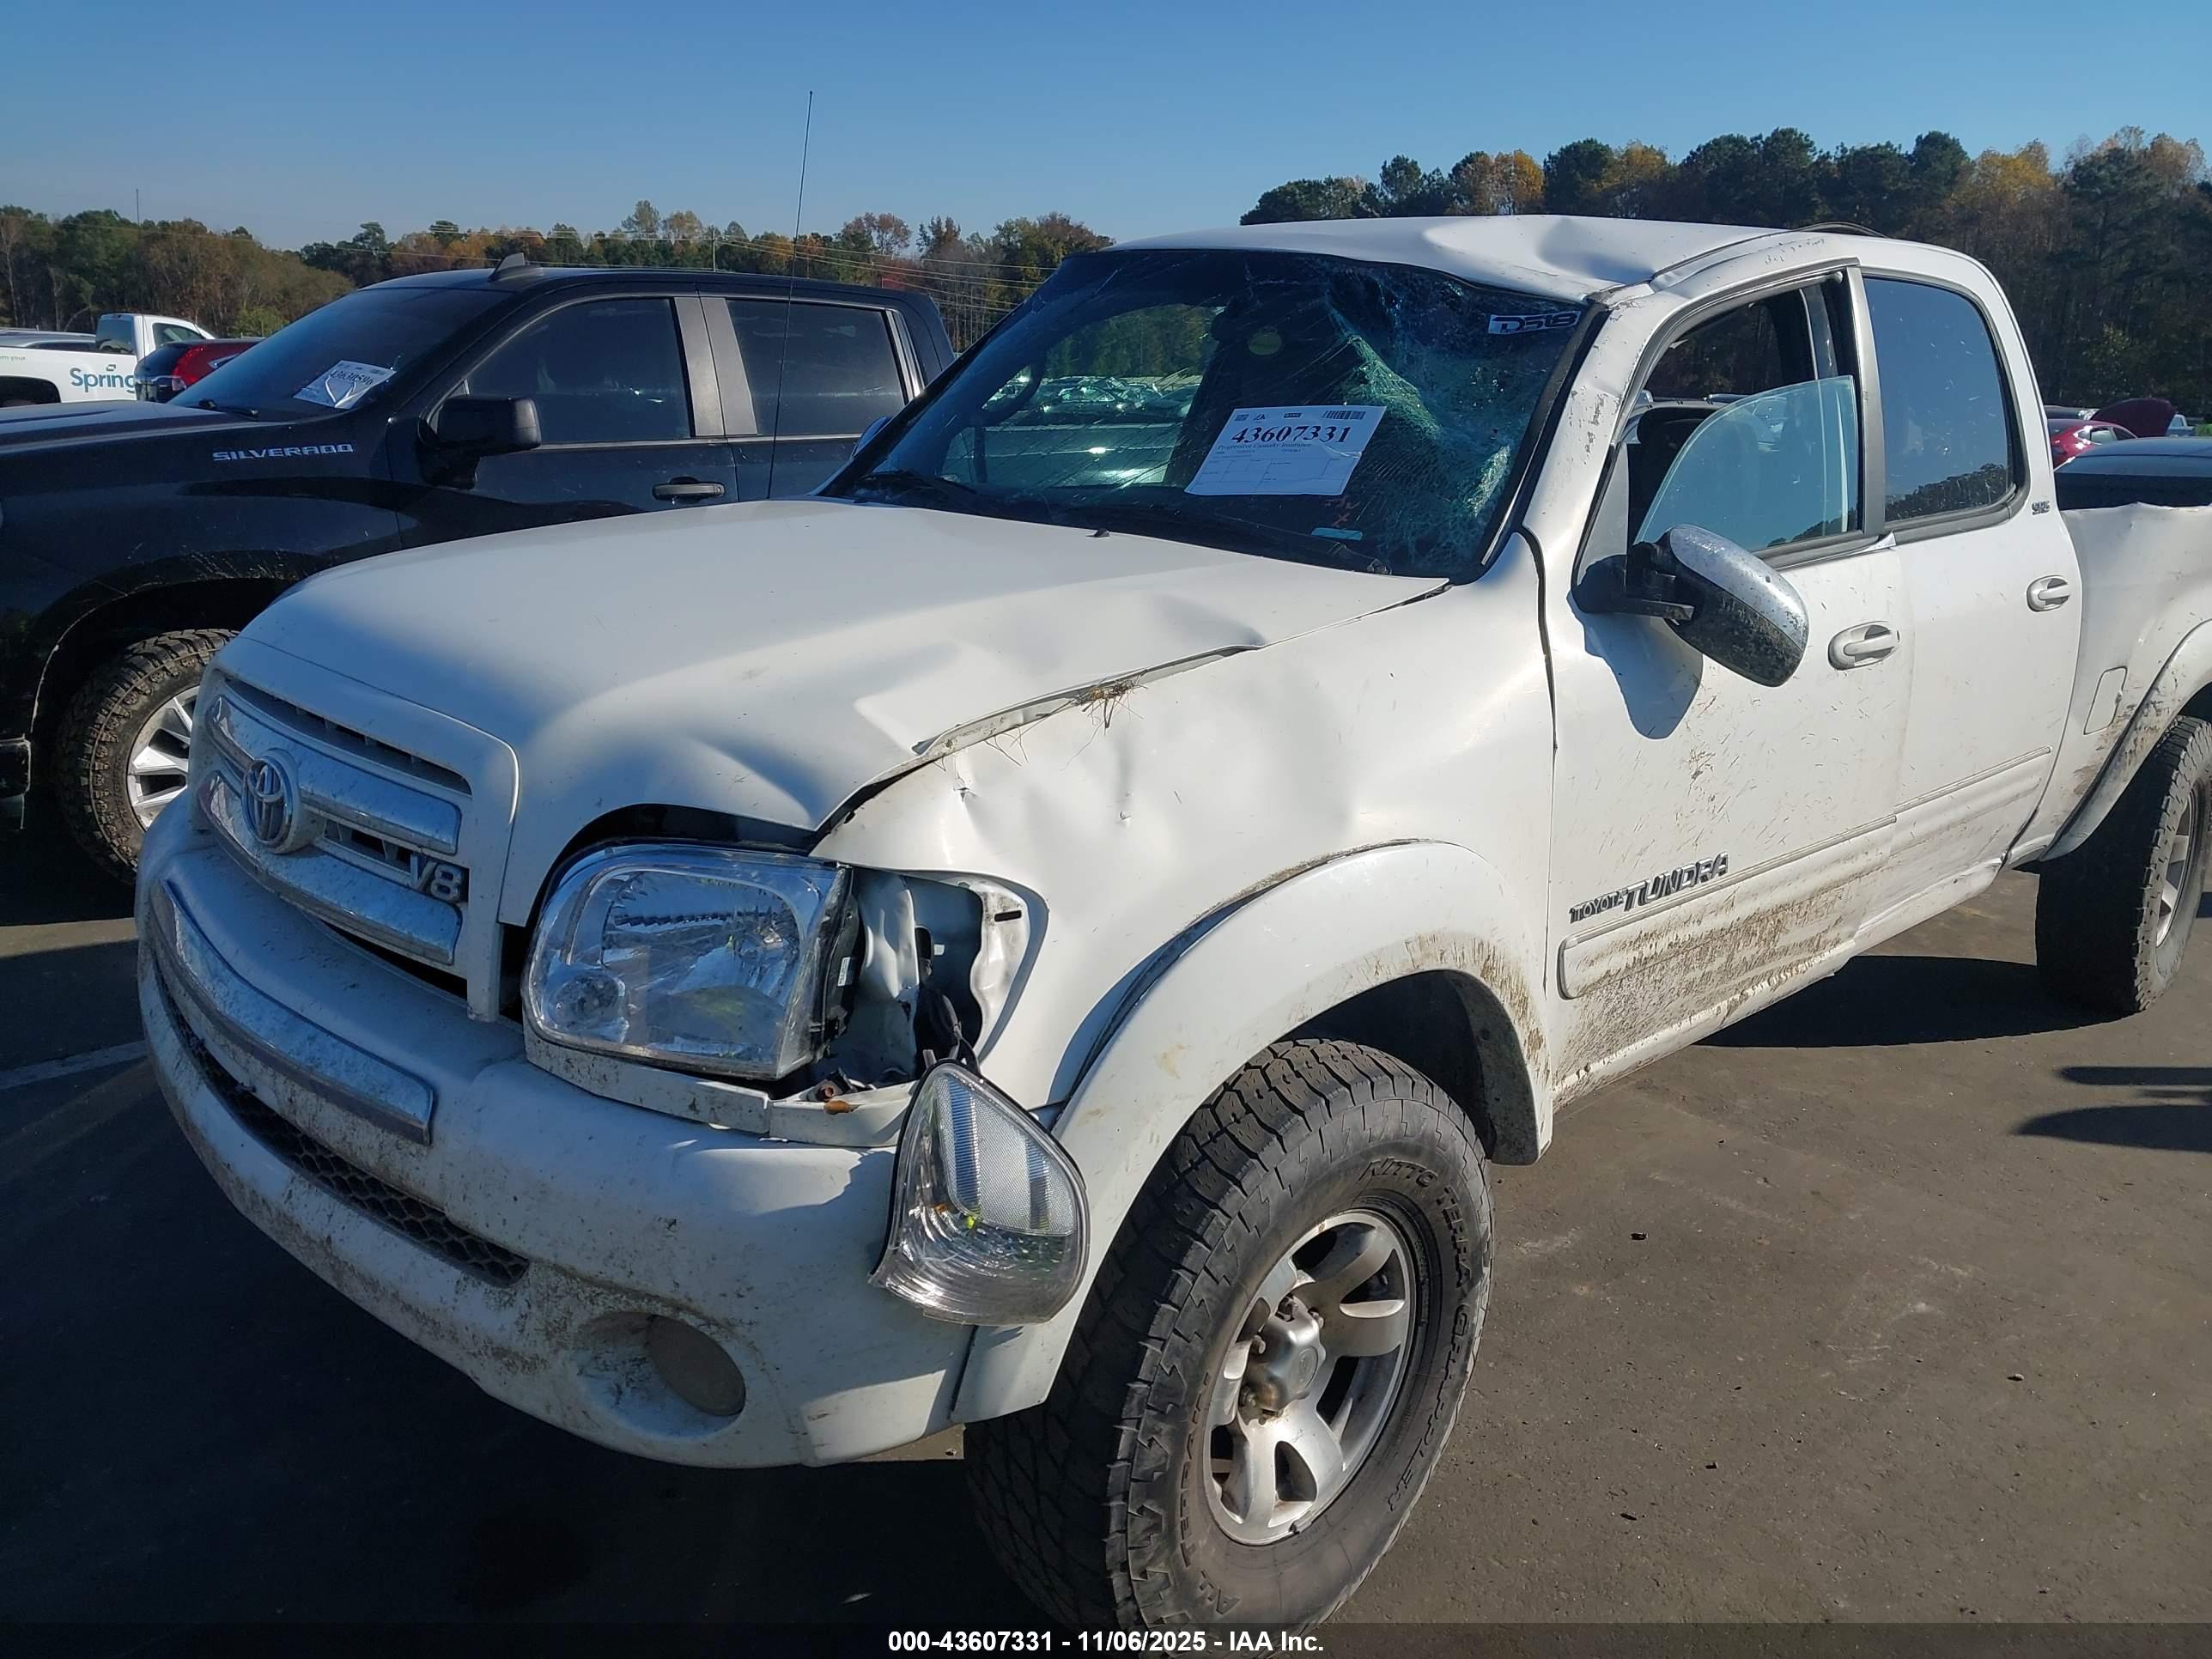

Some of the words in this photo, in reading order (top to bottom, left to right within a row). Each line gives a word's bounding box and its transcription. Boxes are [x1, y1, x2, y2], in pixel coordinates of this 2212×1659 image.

[212, 443, 354, 461] SILVERADO
[1231, 425, 1352, 445] 43607331
[410, 854, 463, 901] V8
[1569, 888, 1626, 924] TOYOTA
[1623, 851, 1729, 912] TUNDRA
[1358, 1156, 1438, 1188] NITTO
[1436, 1185, 1472, 1289] TERRA
